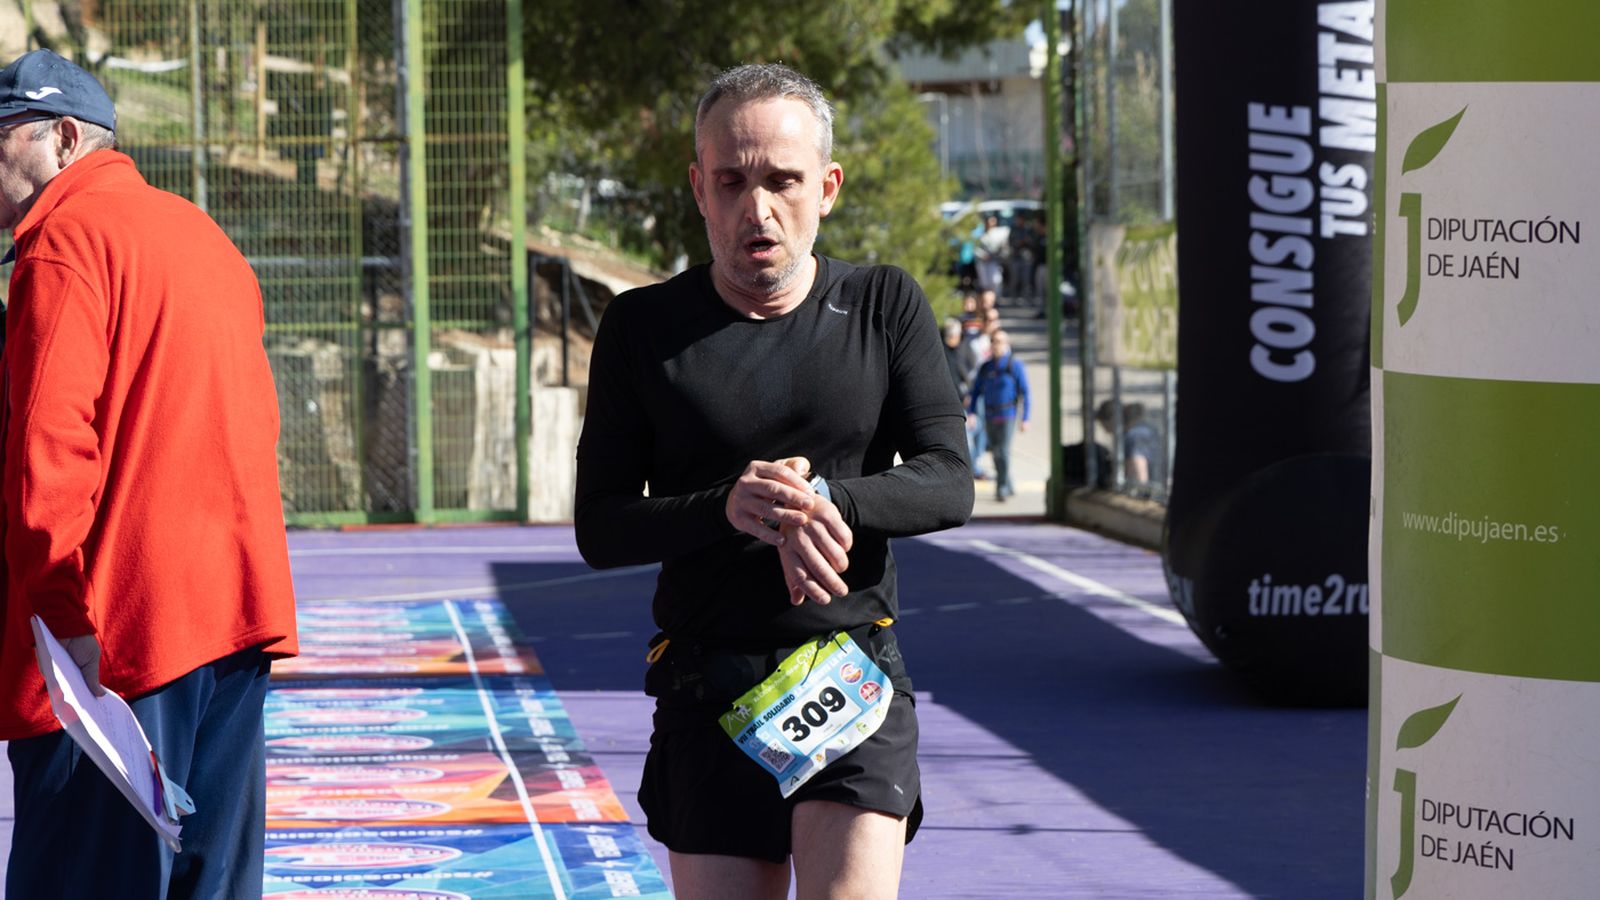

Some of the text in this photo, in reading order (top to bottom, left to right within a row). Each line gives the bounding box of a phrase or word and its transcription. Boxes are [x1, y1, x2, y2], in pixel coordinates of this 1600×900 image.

[1318, 161, 1370, 239] TUS
[1247, 101, 1317, 382] CONSIGUE
[1427, 215, 1581, 244] DIPUTACIÓN
[1427, 251, 1520, 280] DE JAÉN
[1402, 511, 1559, 544] www.dipujaen.es
[745, 718, 764, 737] TRAIL
[762, 693, 795, 721] SOLIDARIO
[782, 686, 847, 742] 309
[1421, 799, 1575, 841] DIPUTACIÓN
[1420, 834, 1514, 872] DE JAÉN
